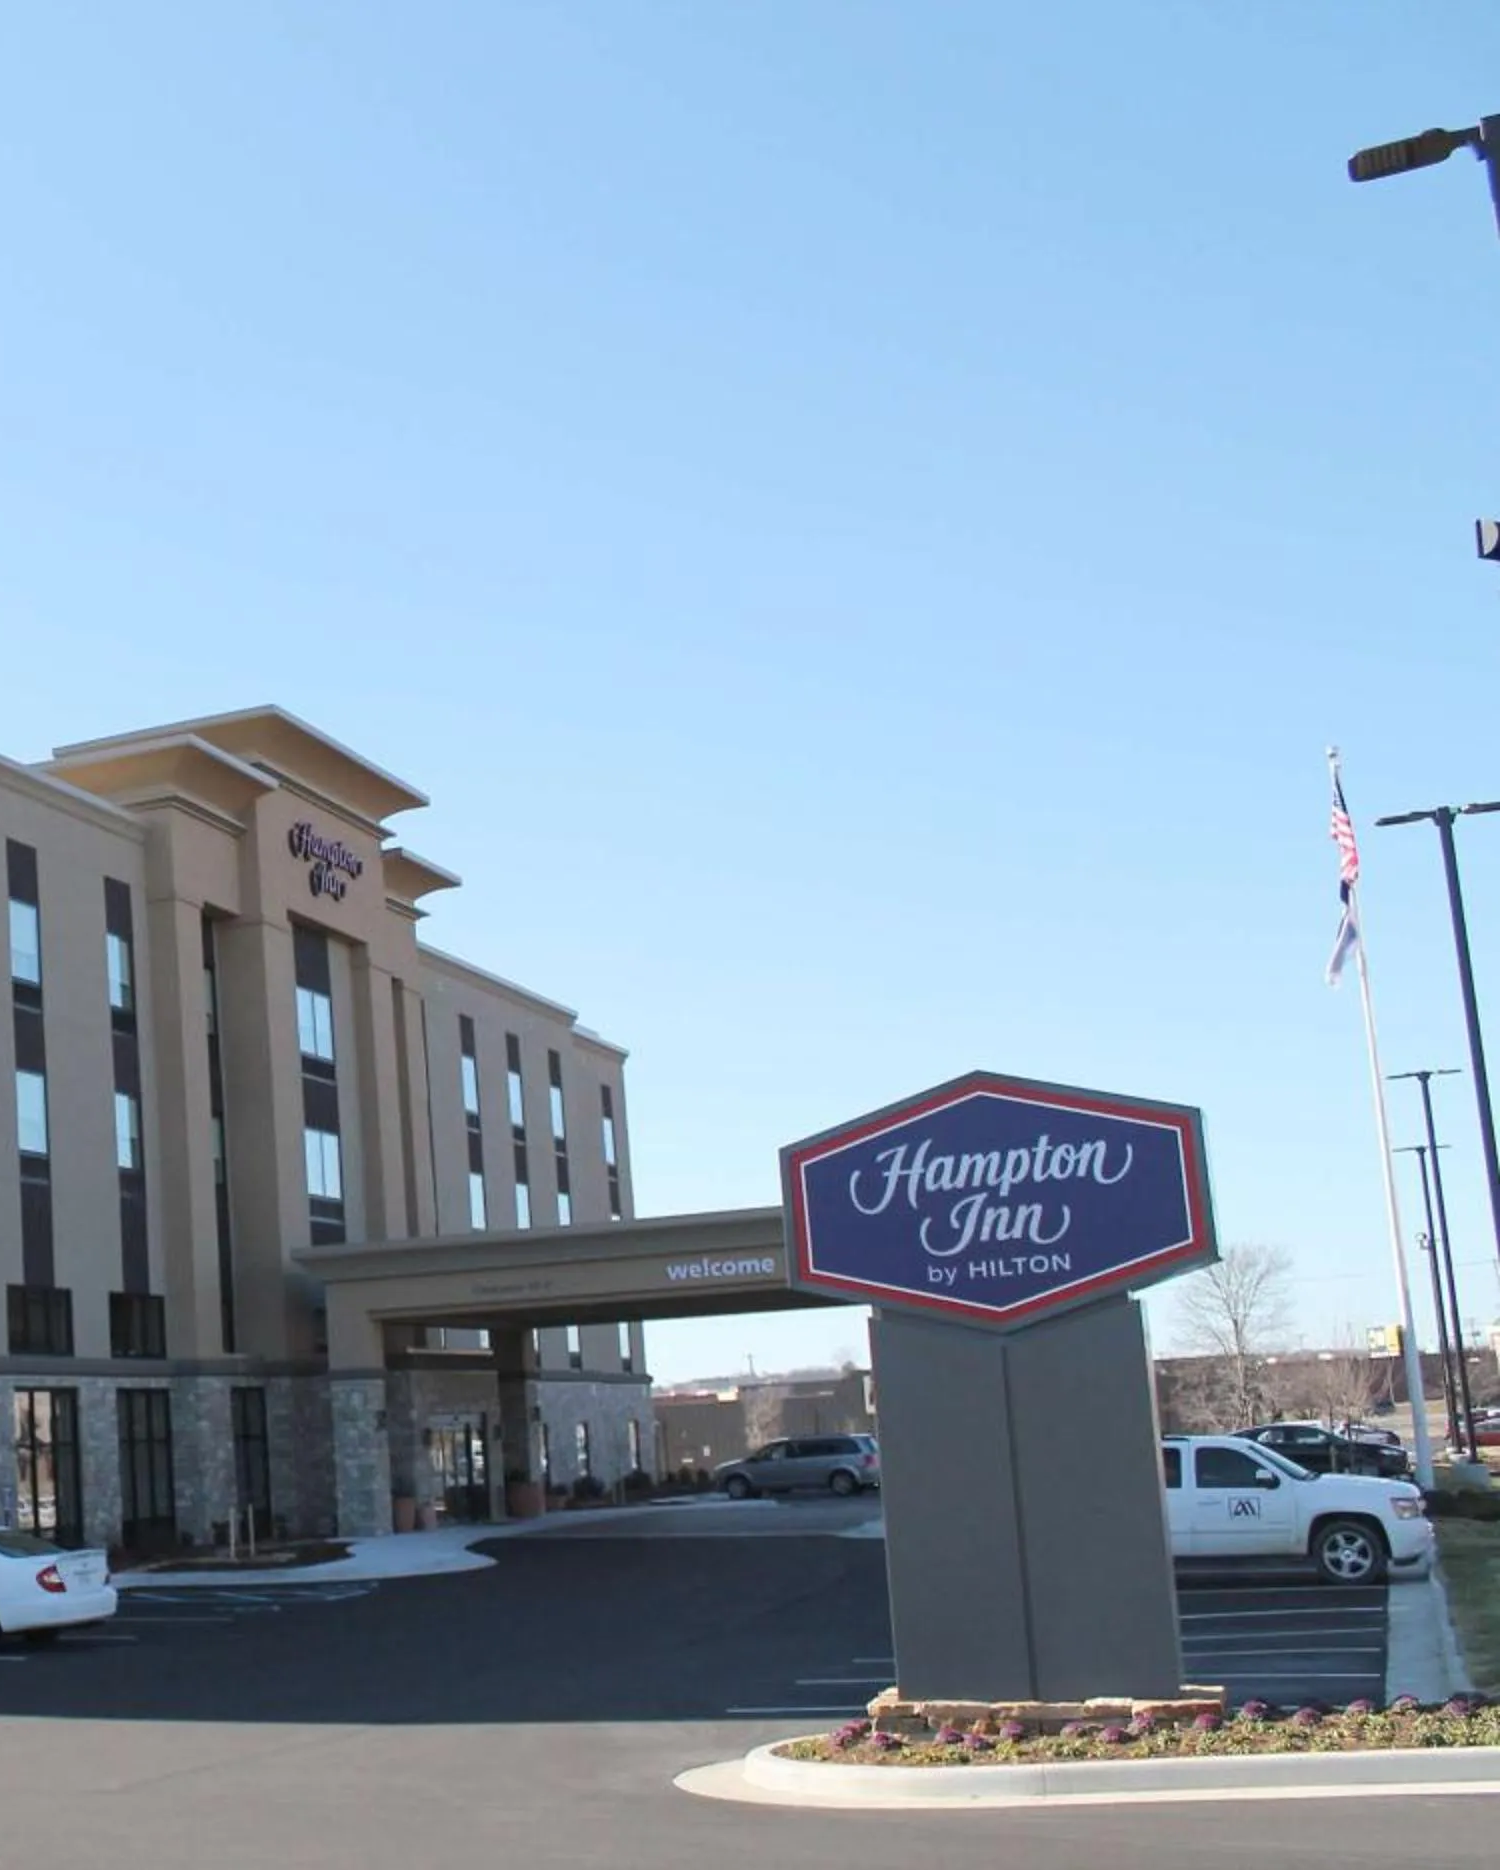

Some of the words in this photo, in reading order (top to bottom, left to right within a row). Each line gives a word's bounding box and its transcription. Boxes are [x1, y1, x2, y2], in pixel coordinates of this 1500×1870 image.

[849, 1133, 1133, 1215] Hampton
[919, 1192, 1071, 1257] Inn
[665, 1255, 776, 1281] welcome
[927, 1263, 957, 1286] by
[968, 1253, 1073, 1280] HILTON
